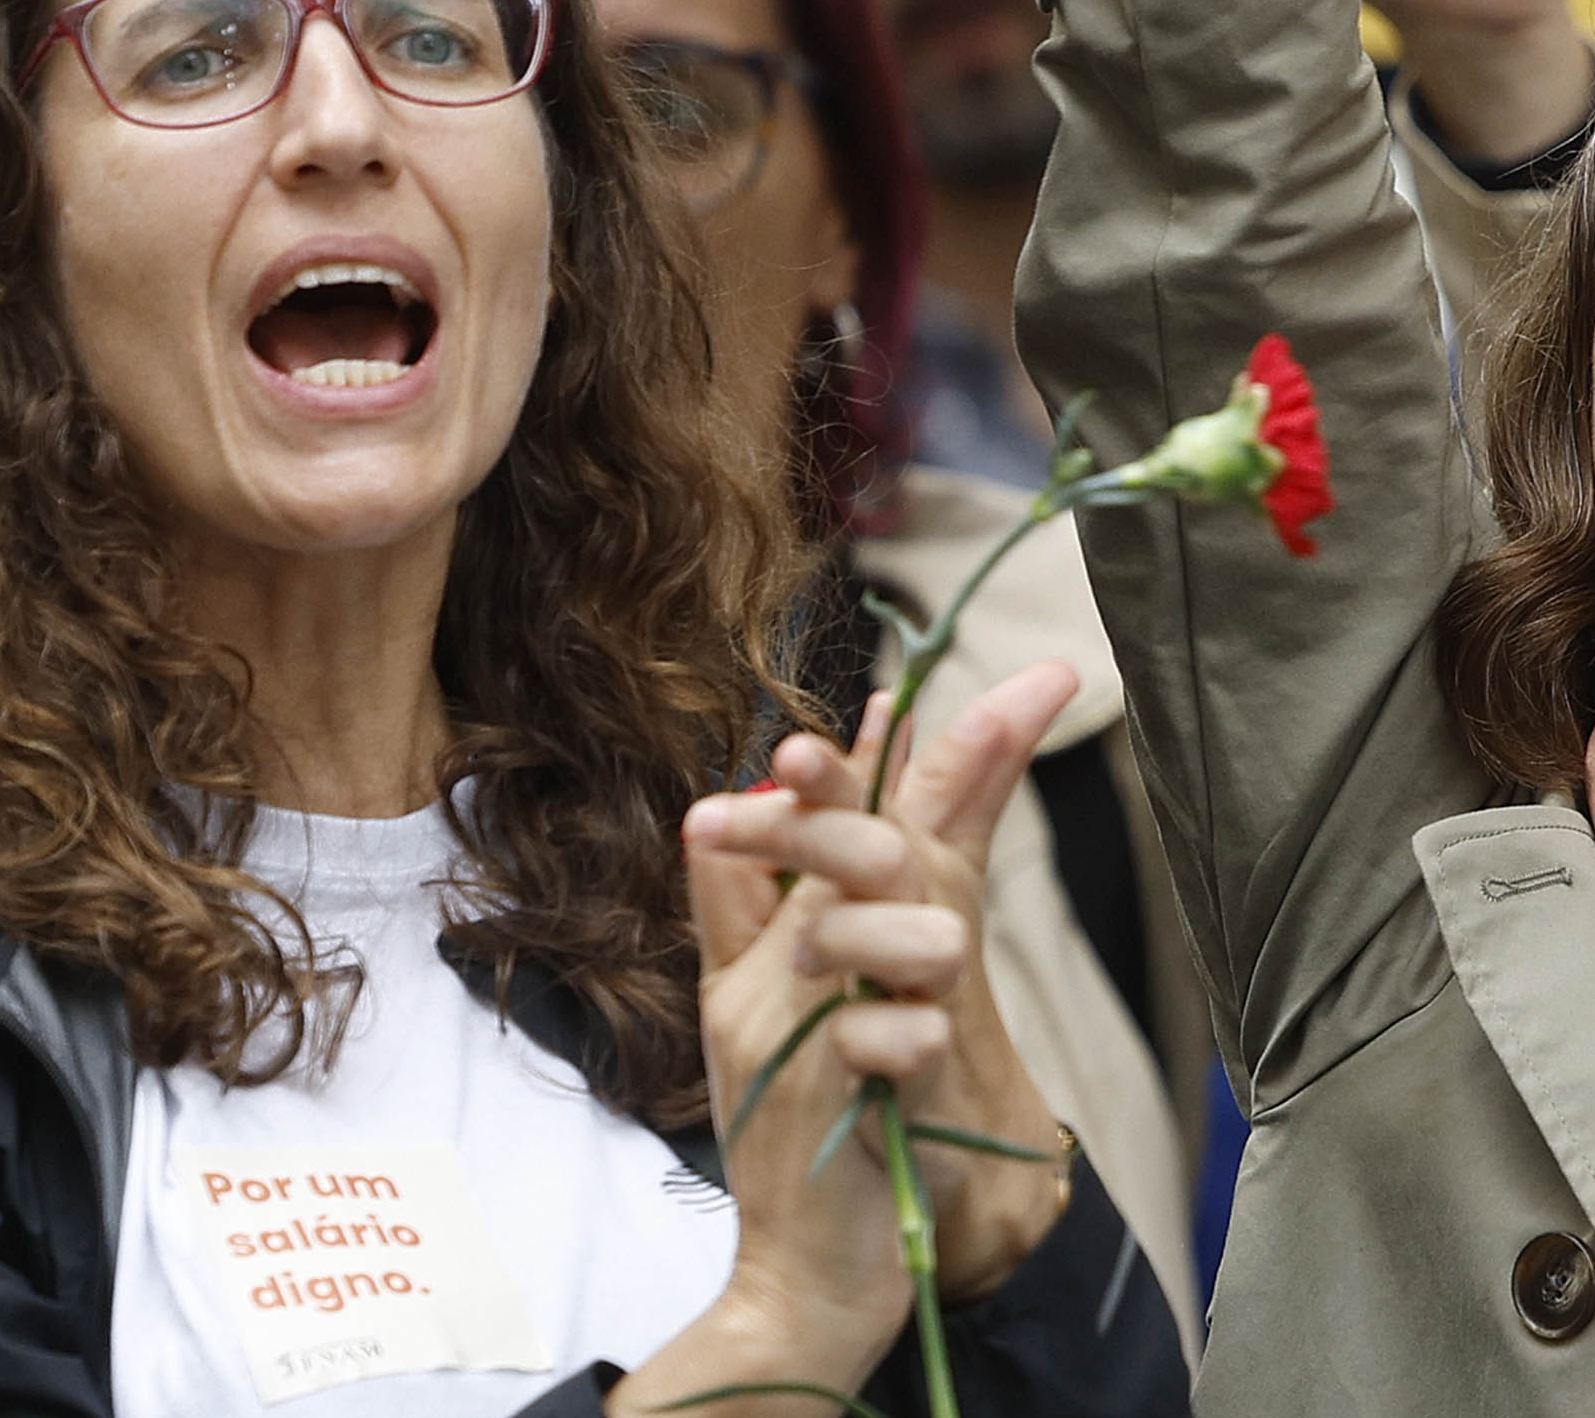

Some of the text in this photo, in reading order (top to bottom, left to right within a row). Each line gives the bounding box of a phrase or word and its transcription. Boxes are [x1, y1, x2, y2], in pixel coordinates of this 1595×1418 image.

[201, 1171, 400, 1205] Por um
[227, 1213, 421, 1257] salário
[251, 1270, 431, 1312] digno.
